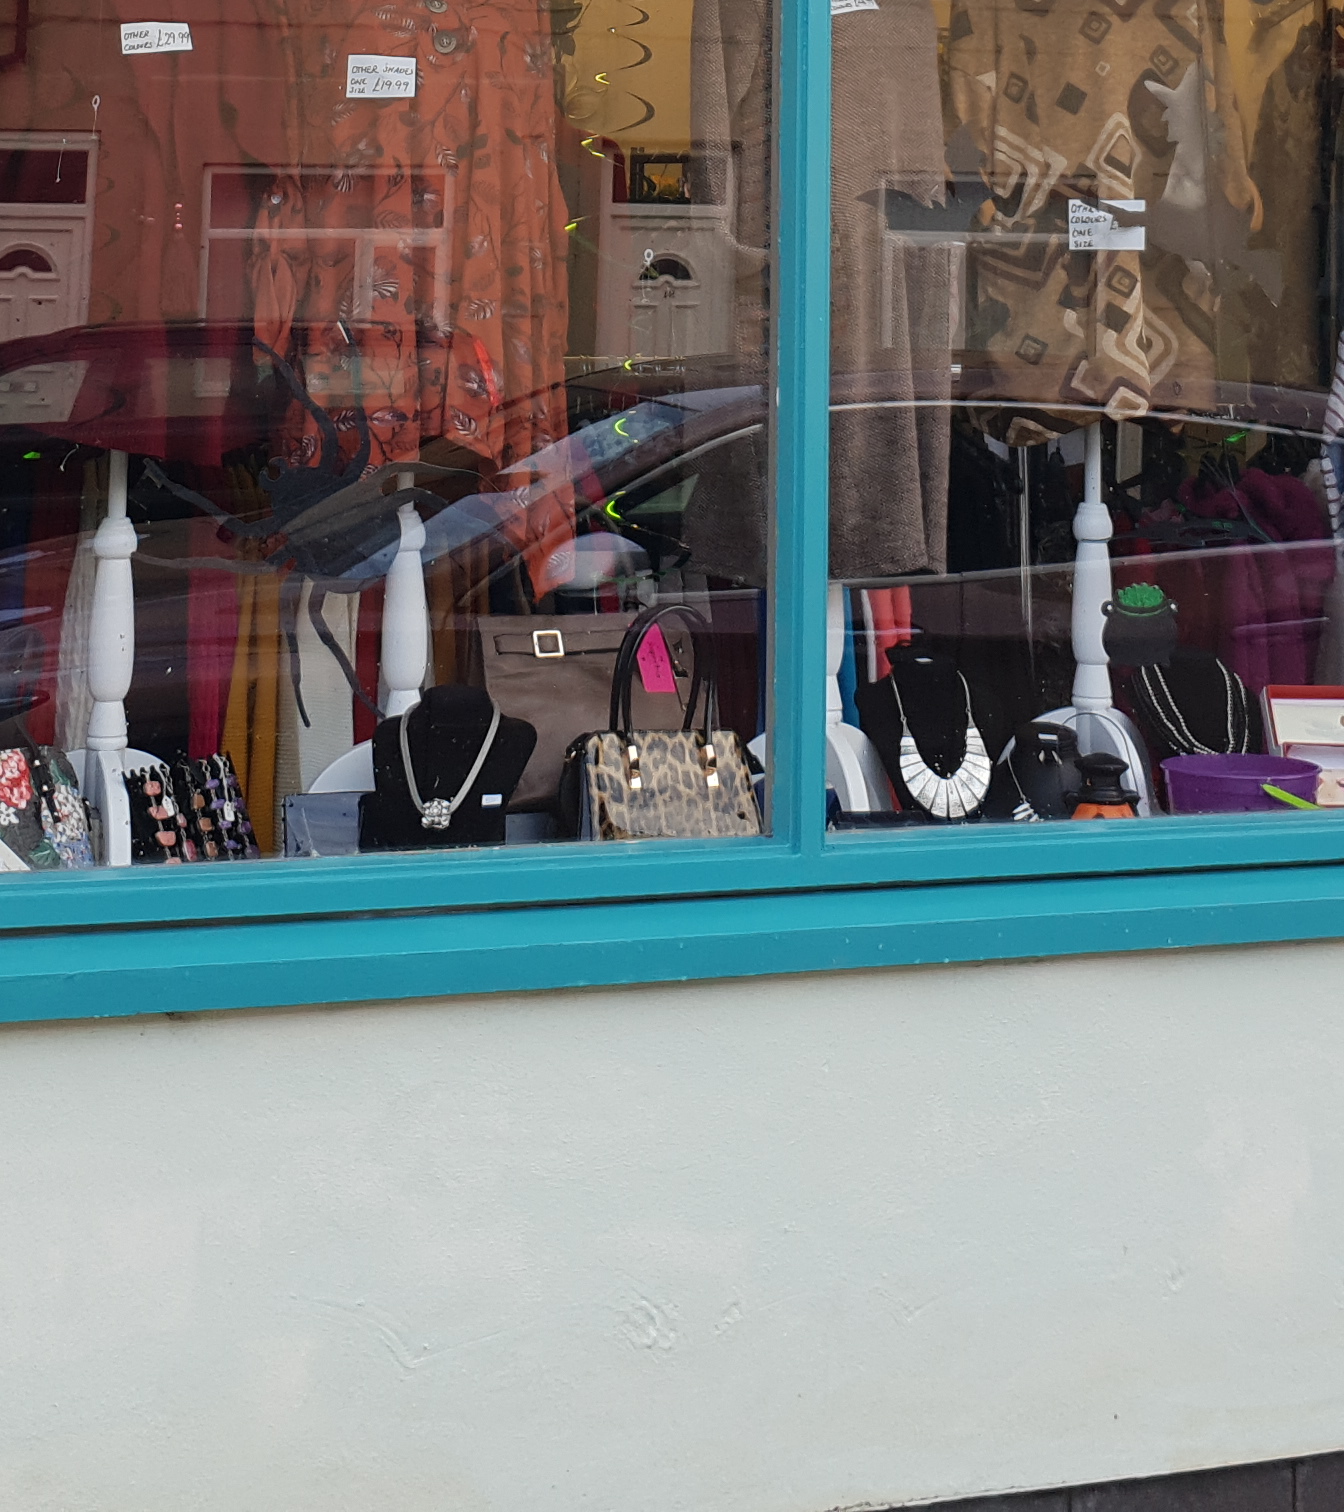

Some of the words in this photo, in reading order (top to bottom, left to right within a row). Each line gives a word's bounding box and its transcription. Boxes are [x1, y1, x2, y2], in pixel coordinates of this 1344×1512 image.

[123, 30, 150, 40] OTHER
[156, 28, 191, 47] £29.99
[351, 65, 380, 75] OTHER
[350, 78, 368, 86] ONE
[372, 79, 410, 93] £19.99
[1070, 215, 1108, 224] COLOURS
[1072, 228, 1094, 237] ONE
